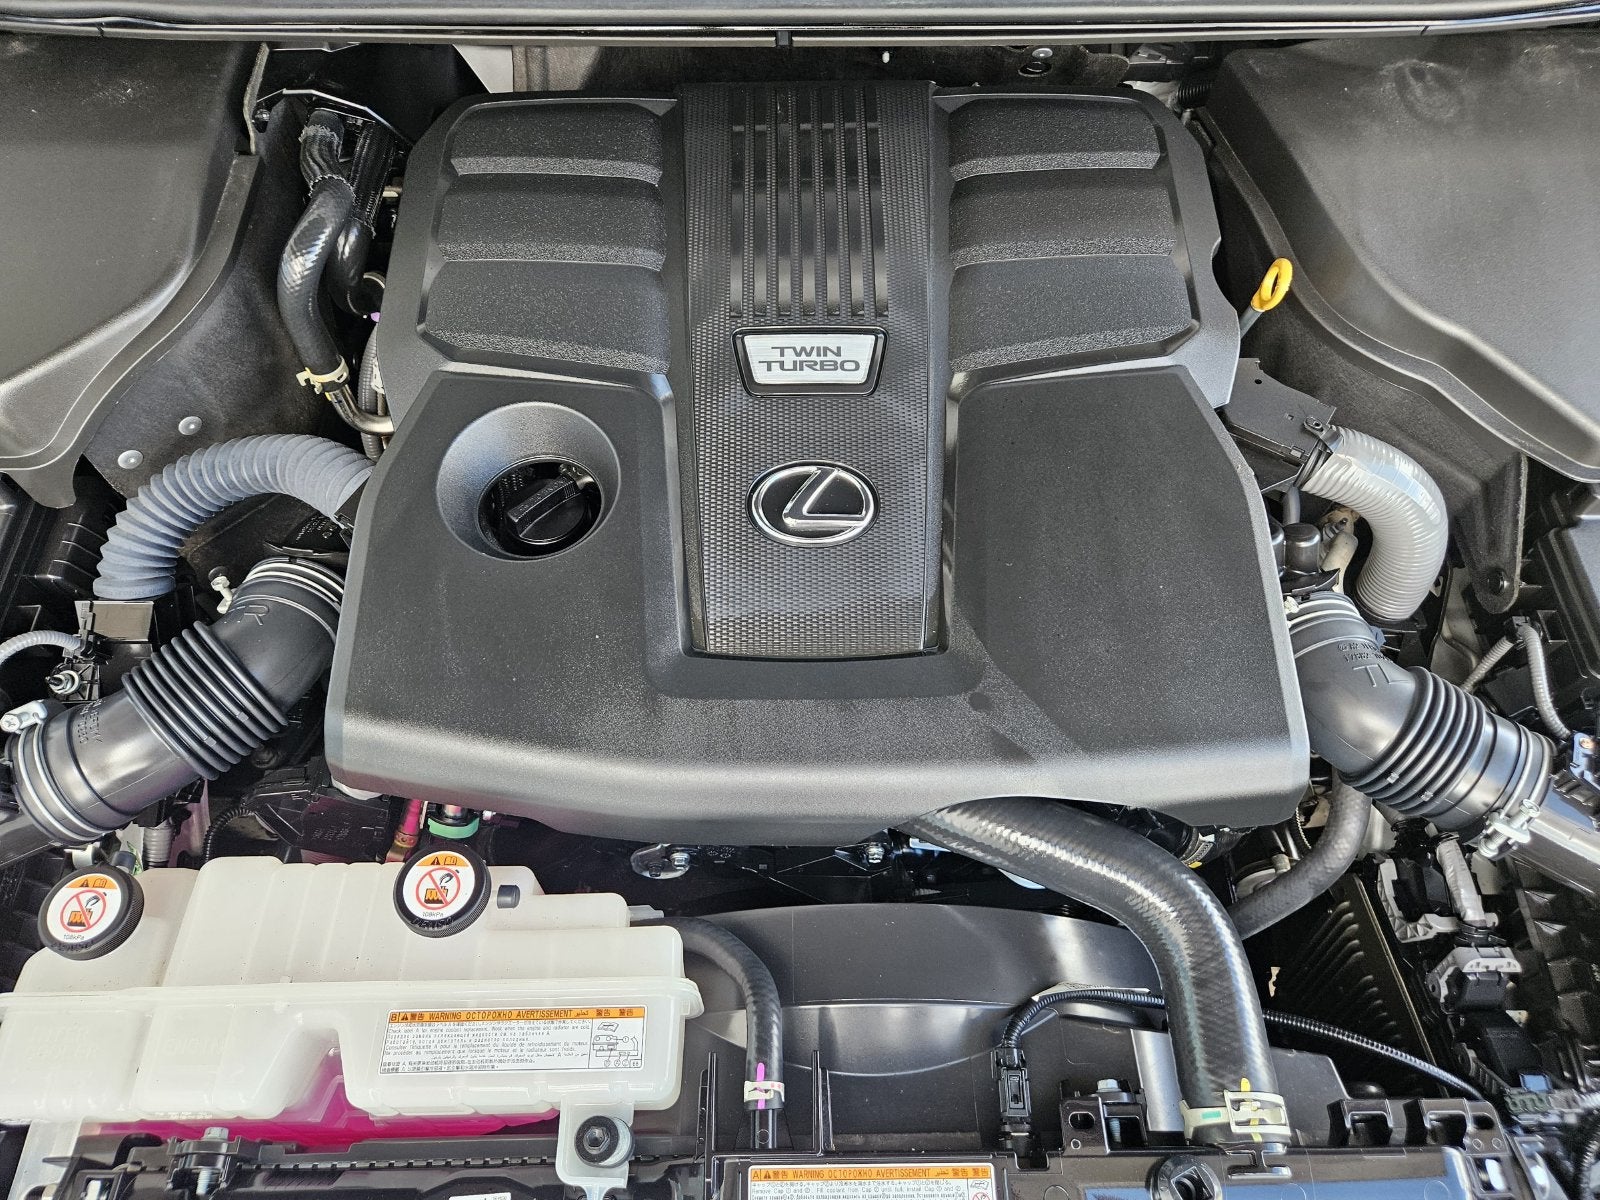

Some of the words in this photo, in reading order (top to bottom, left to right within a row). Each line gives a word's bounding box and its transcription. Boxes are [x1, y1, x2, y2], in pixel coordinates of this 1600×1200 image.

[771, 346, 842, 358] TWIN
[758, 360, 861, 372] TURBO
[390, 1013, 397, 1021] B
[429, 1012, 462, 1020] WARNING
[516, 1009, 574, 1019] AVERTISSEMENT
[752, 1171, 760, 1179] A
[793, 1170, 825, 1179] WARNING
[876, 1167, 931, 1177] AVERTISSEMENT
